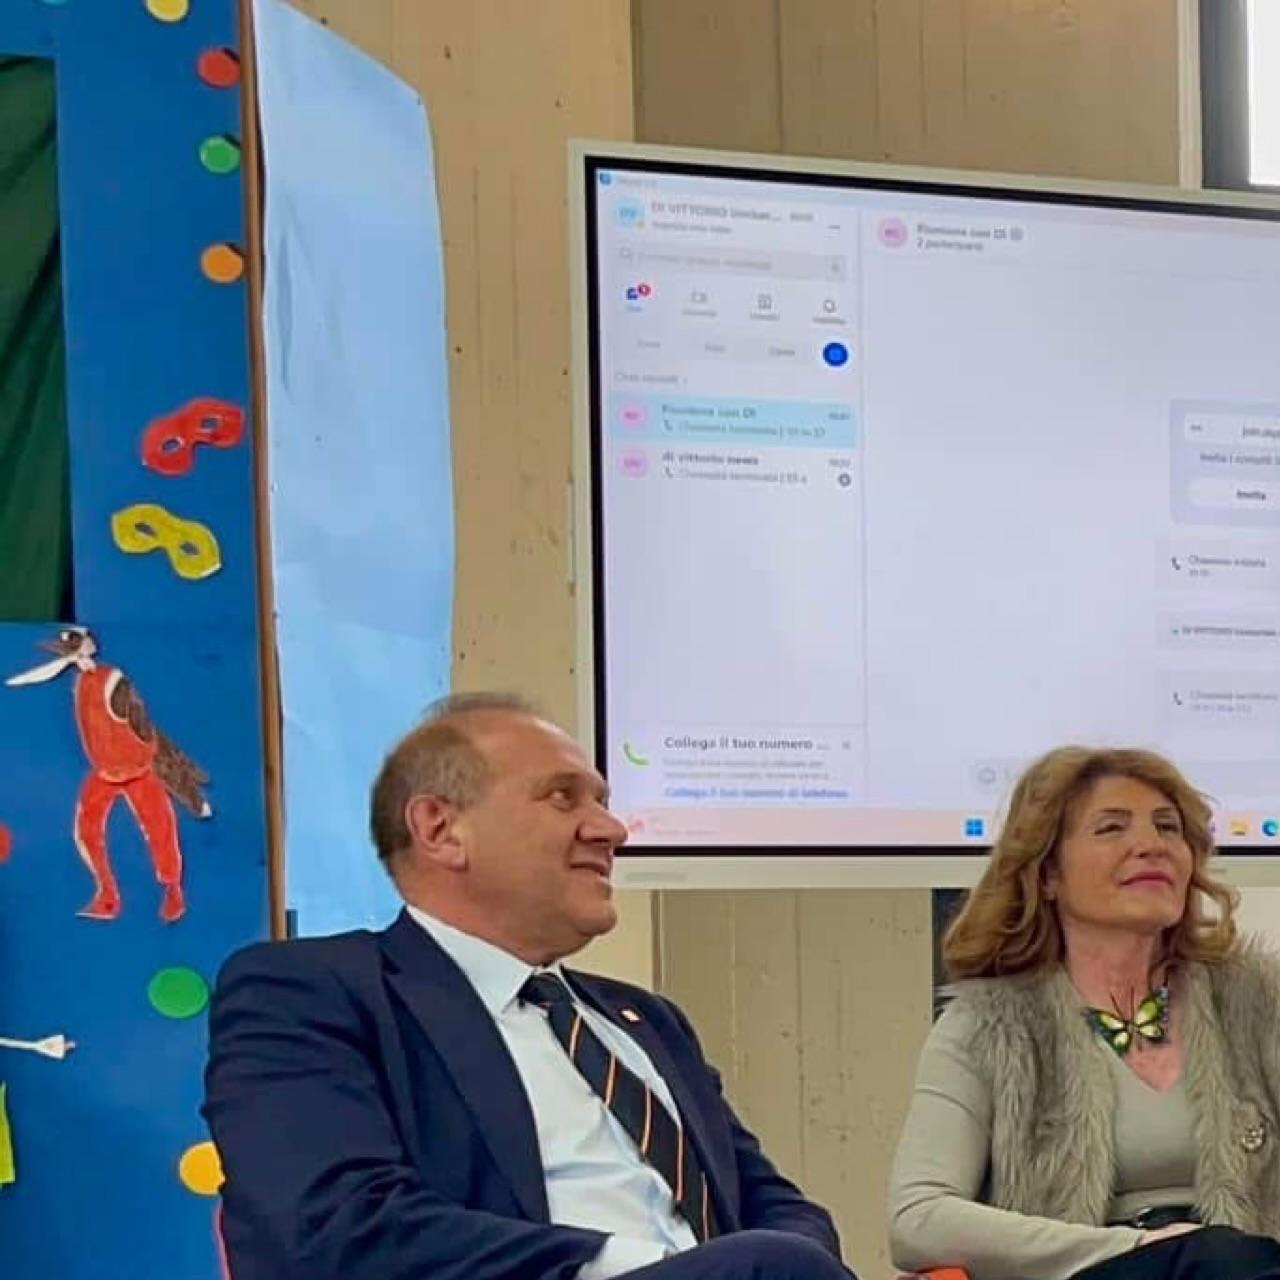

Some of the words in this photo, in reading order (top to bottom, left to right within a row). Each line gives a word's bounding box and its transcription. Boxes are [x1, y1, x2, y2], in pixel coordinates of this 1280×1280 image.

[664, 736, 717, 750] Collega
[732, 737, 758, 750] tuo
[759, 739, 813, 750] numero
